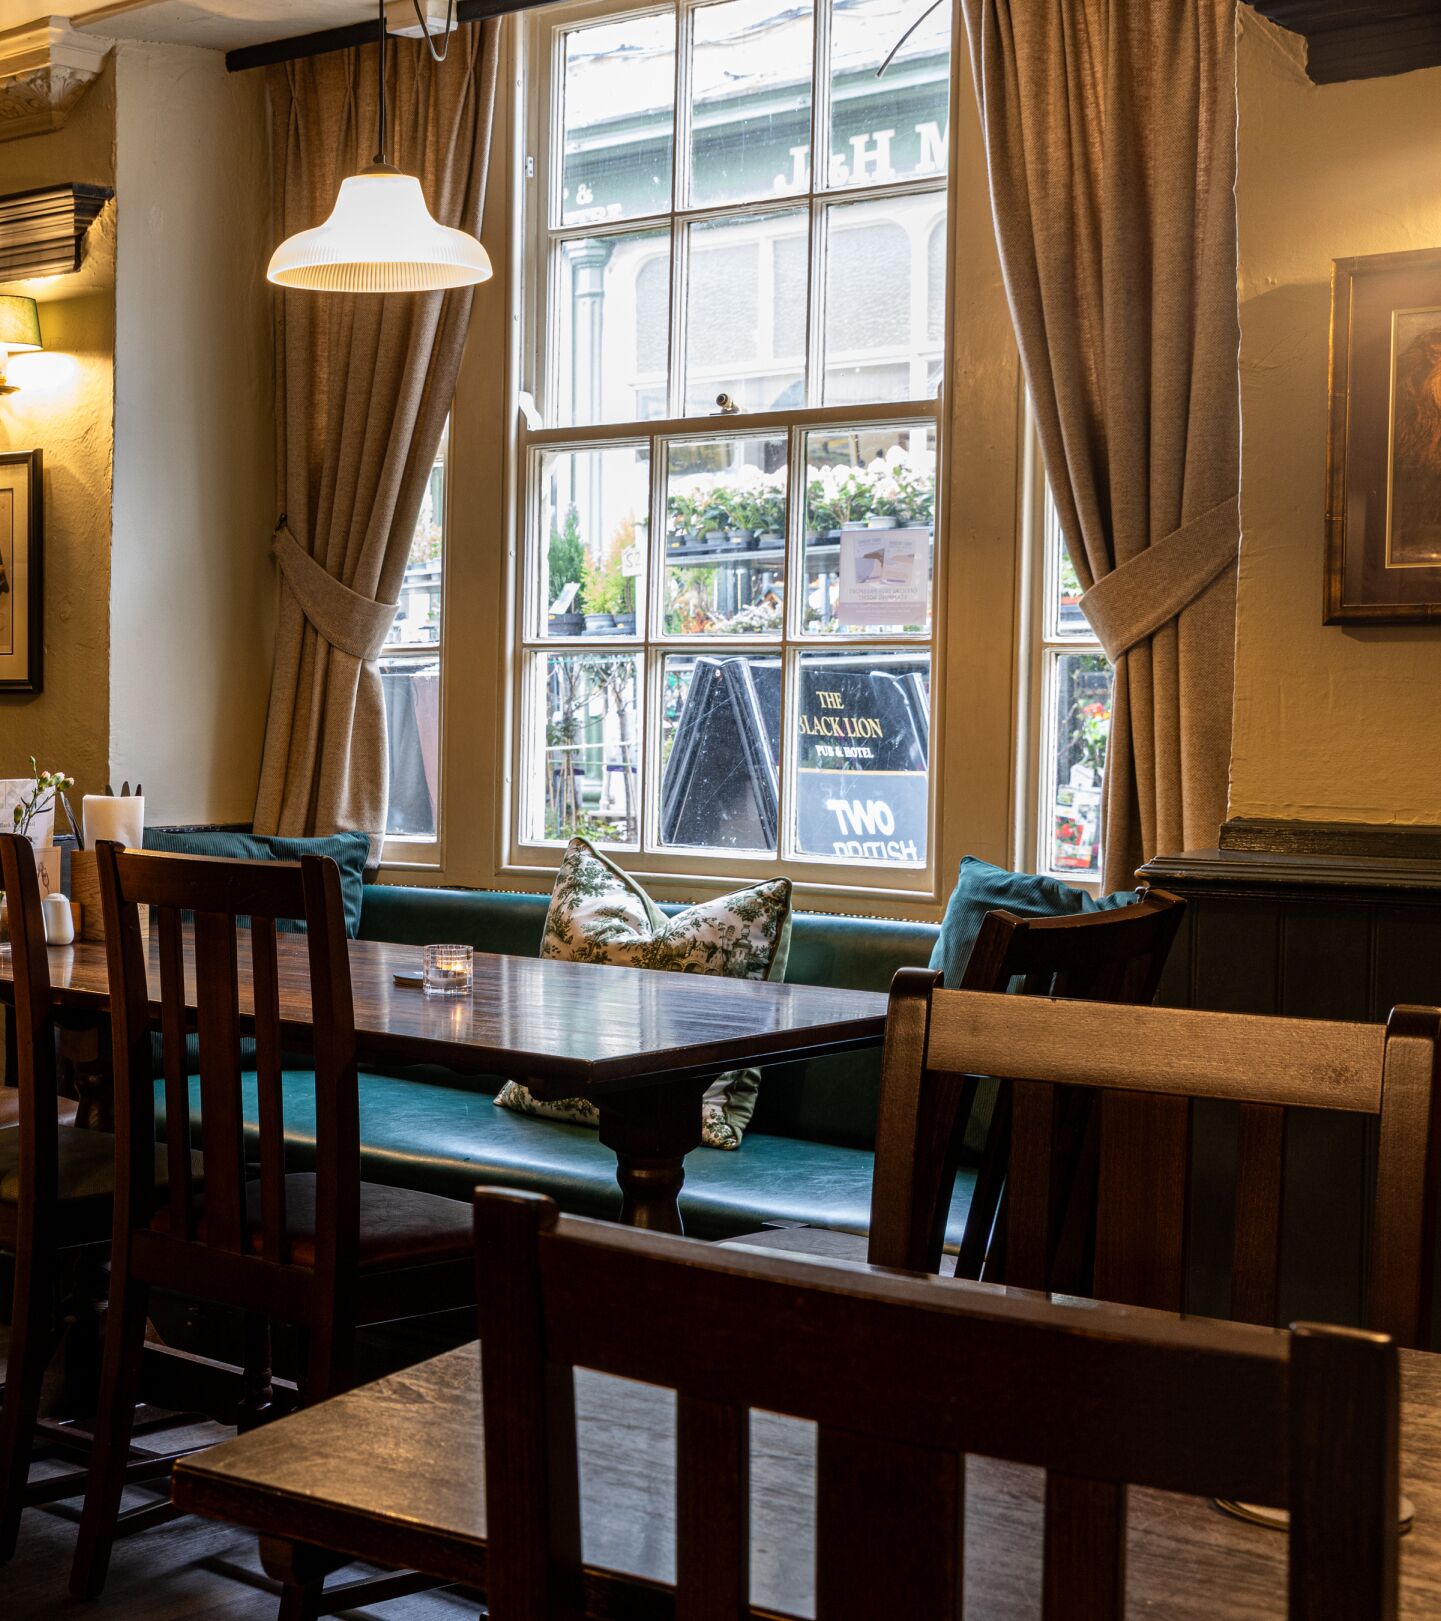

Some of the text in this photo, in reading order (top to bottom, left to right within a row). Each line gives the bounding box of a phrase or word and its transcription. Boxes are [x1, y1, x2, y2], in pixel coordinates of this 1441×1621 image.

[816, 691, 845, 709] THE
[843, 717, 883, 738] LION
[815, 744, 875, 758] PUB & HOTEL
[825, 799, 896, 836] TWO
